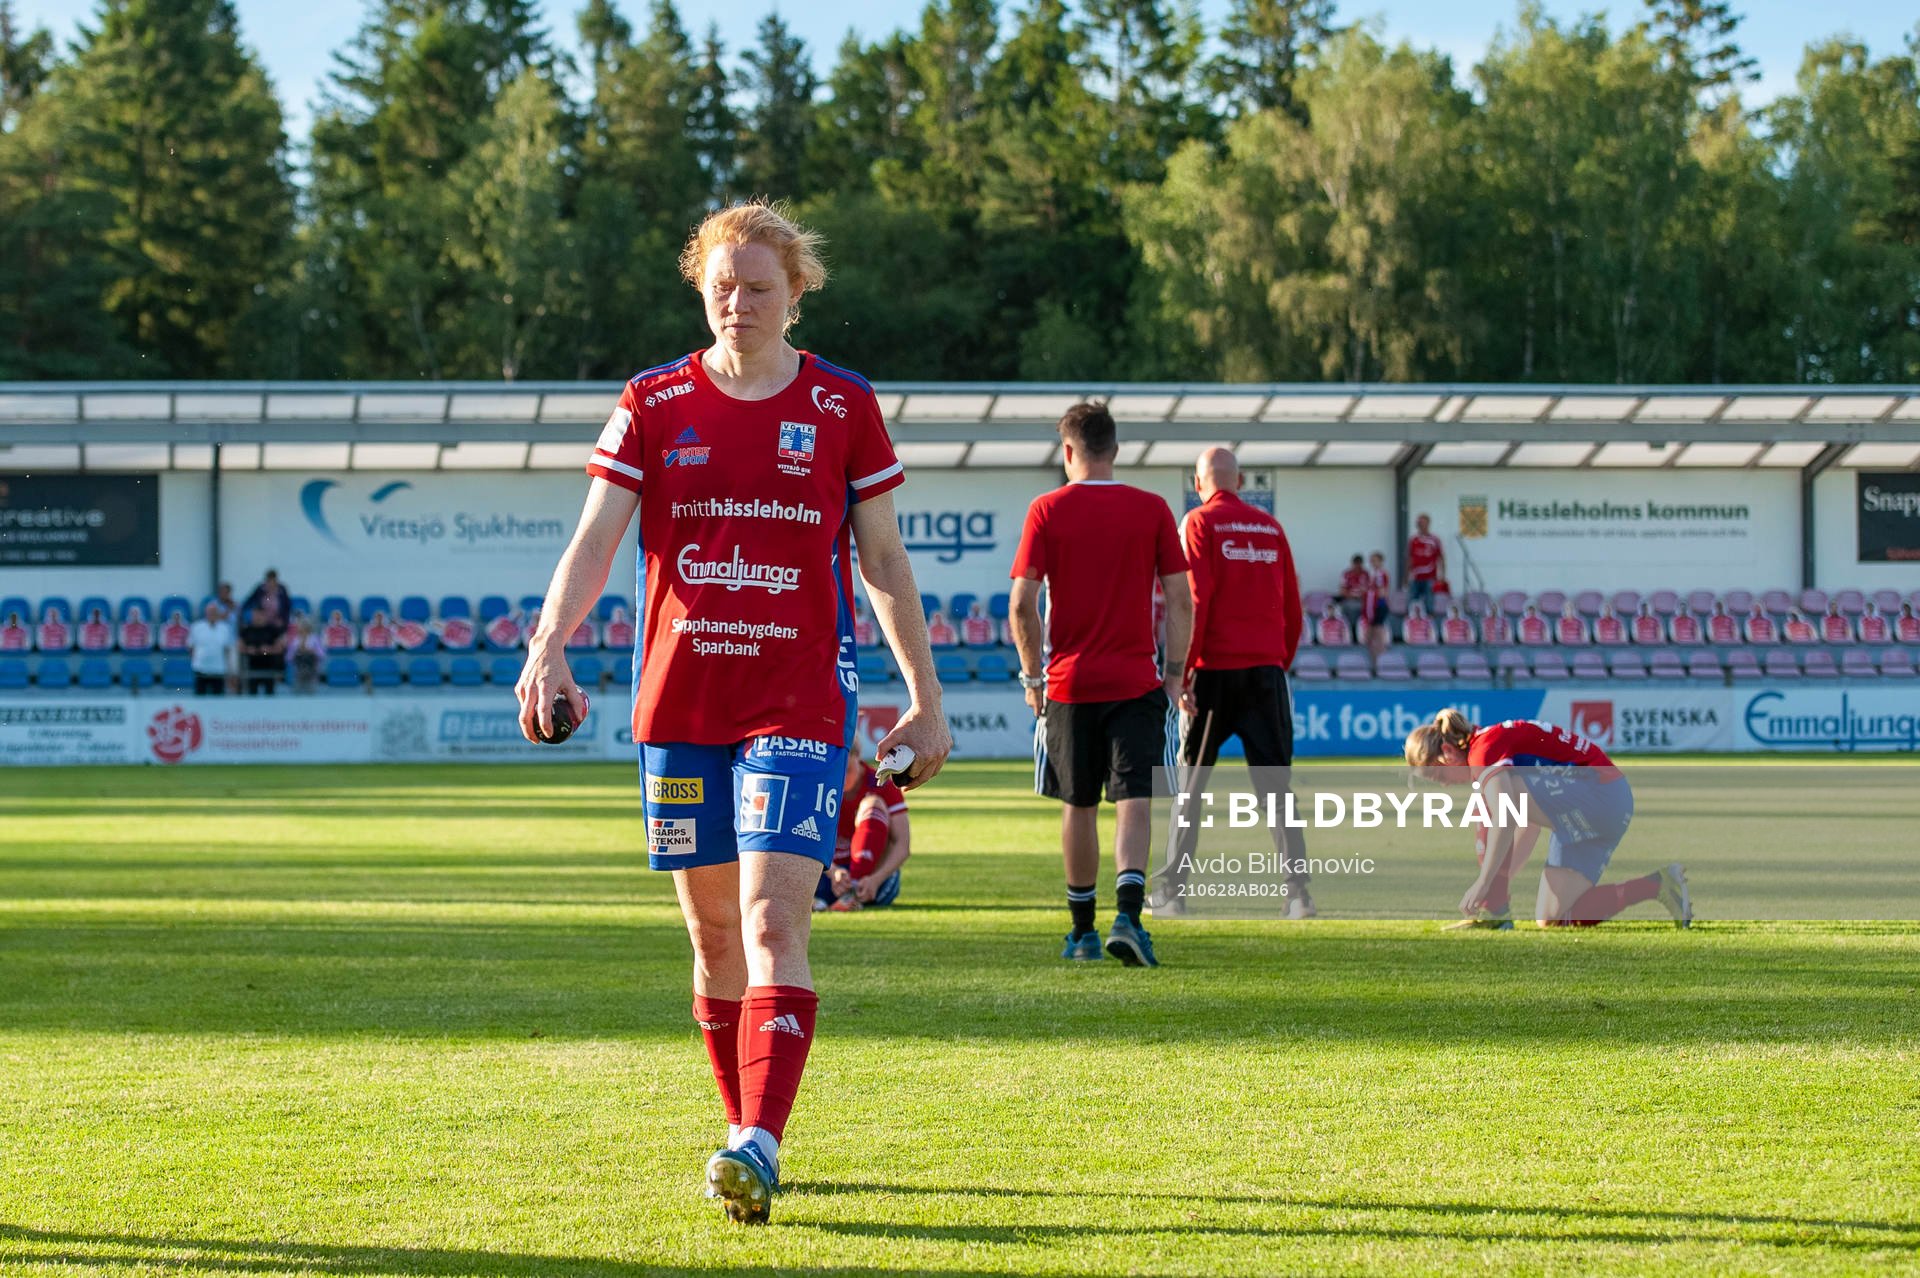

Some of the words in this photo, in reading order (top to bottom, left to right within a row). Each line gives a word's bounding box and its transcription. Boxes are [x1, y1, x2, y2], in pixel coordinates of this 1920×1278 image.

[655, 381, 695, 402] NIBE
[822, 398, 848, 419] SHG
[671, 498, 822, 525] #mitthässleholm
[1498, 499, 1642, 520] Hässleholms
[1647, 499, 1749, 520] kommun
[361, 514, 446, 545] Vittsjö
[453, 513, 564, 544] Sjukhem
[677, 543, 801, 594] Emmaljunga
[692, 638, 761, 656] Sparbank
[949, 711, 1009, 732] NSKA
[1621, 707, 1719, 727] SVENSKA
[1744, 690, 1920, 752] Emmaljung
[1621, 728, 1673, 747] SPEL
[653, 781, 699, 799] GROSS
[814, 783, 837, 818] 16
[651, 828, 687, 837] GARPS
[791, 827, 821, 842] adidas
[759, 1022, 805, 1039] adidas
